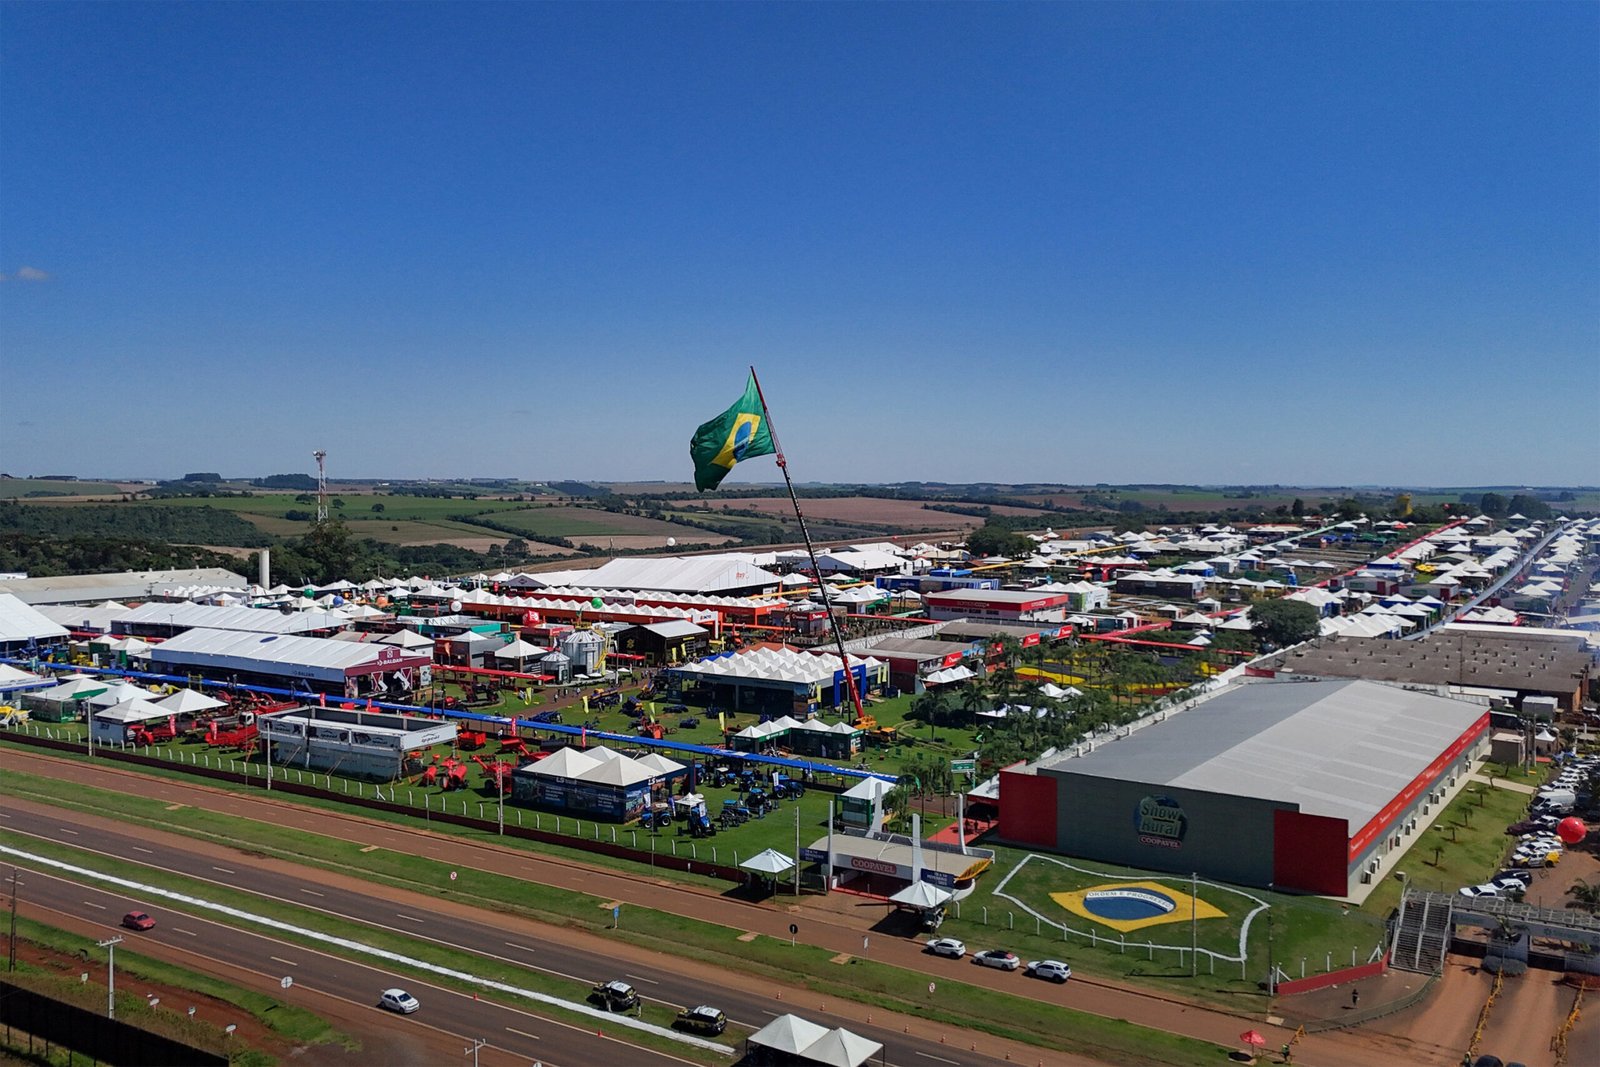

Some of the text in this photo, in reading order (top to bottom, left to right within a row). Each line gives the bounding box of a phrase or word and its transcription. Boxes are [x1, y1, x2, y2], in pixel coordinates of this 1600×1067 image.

[647, 777, 656, 786] LS
[1141, 803, 1179, 819] Show
[1142, 821, 1178, 835] Rural
[852, 859, 896, 872] COOPAVEL
